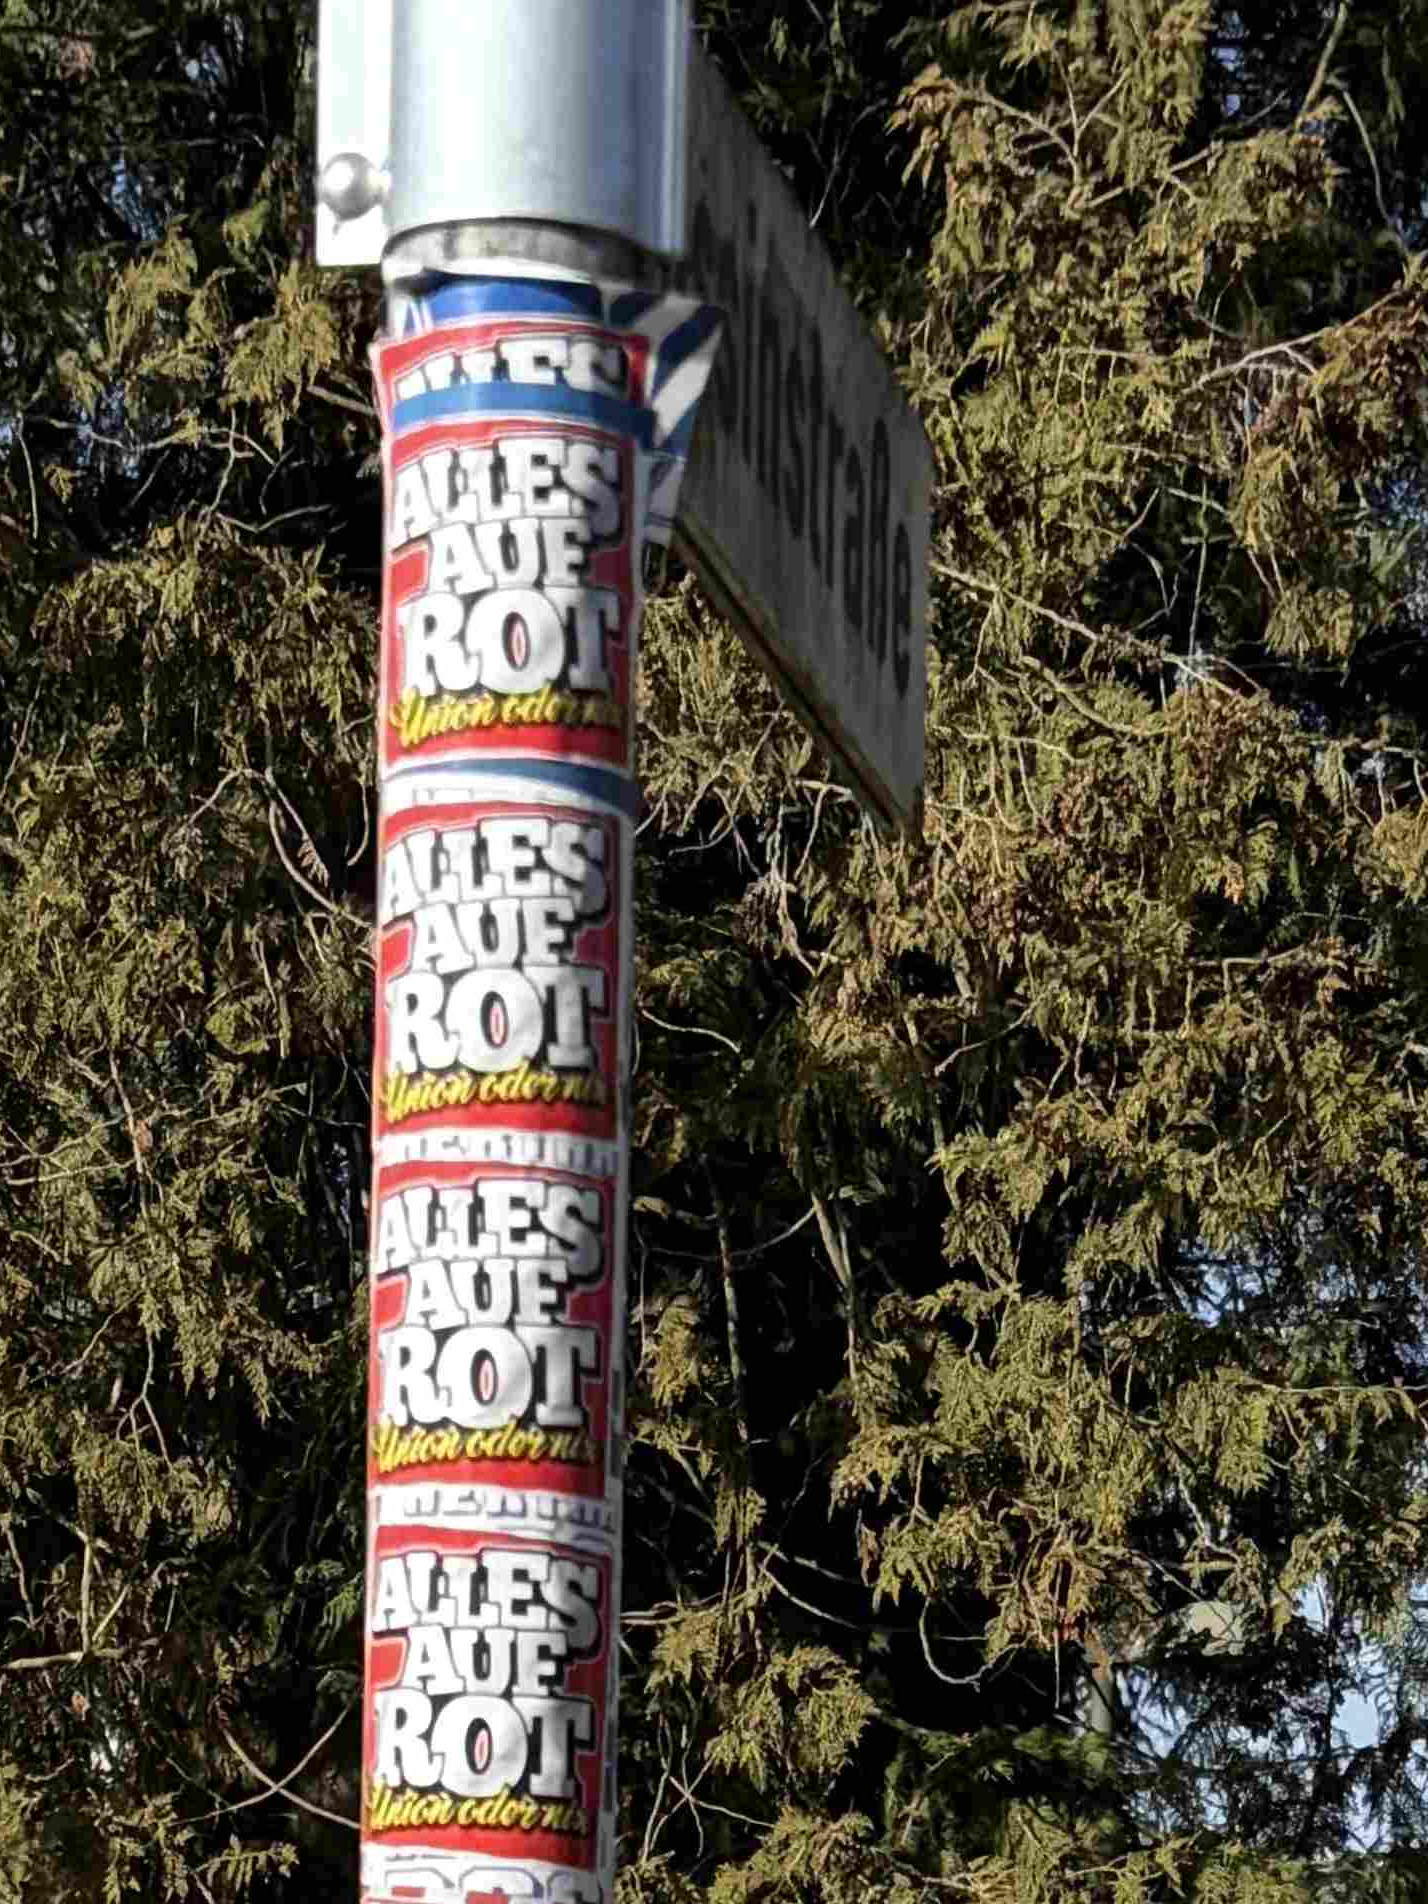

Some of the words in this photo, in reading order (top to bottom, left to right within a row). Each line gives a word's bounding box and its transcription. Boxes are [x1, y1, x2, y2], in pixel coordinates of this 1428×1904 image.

[391, 436, 621, 550] ALLES
[428, 518, 590, 594] AUF
[395, 587, 621, 695] ROT
[384, 818, 607, 923] ALLES
[413, 897, 574, 974] AUF
[385, 966, 605, 1072] ROT
[375, 1180, 600, 1280] ALLES
[406, 1258, 568, 1330] AUF
[378, 1325, 599, 1428] ROT
[372, 1550, 599, 1650] ALLES
[403, 1624, 568, 1697] AUF
[374, 1688, 592, 1797] ROT
